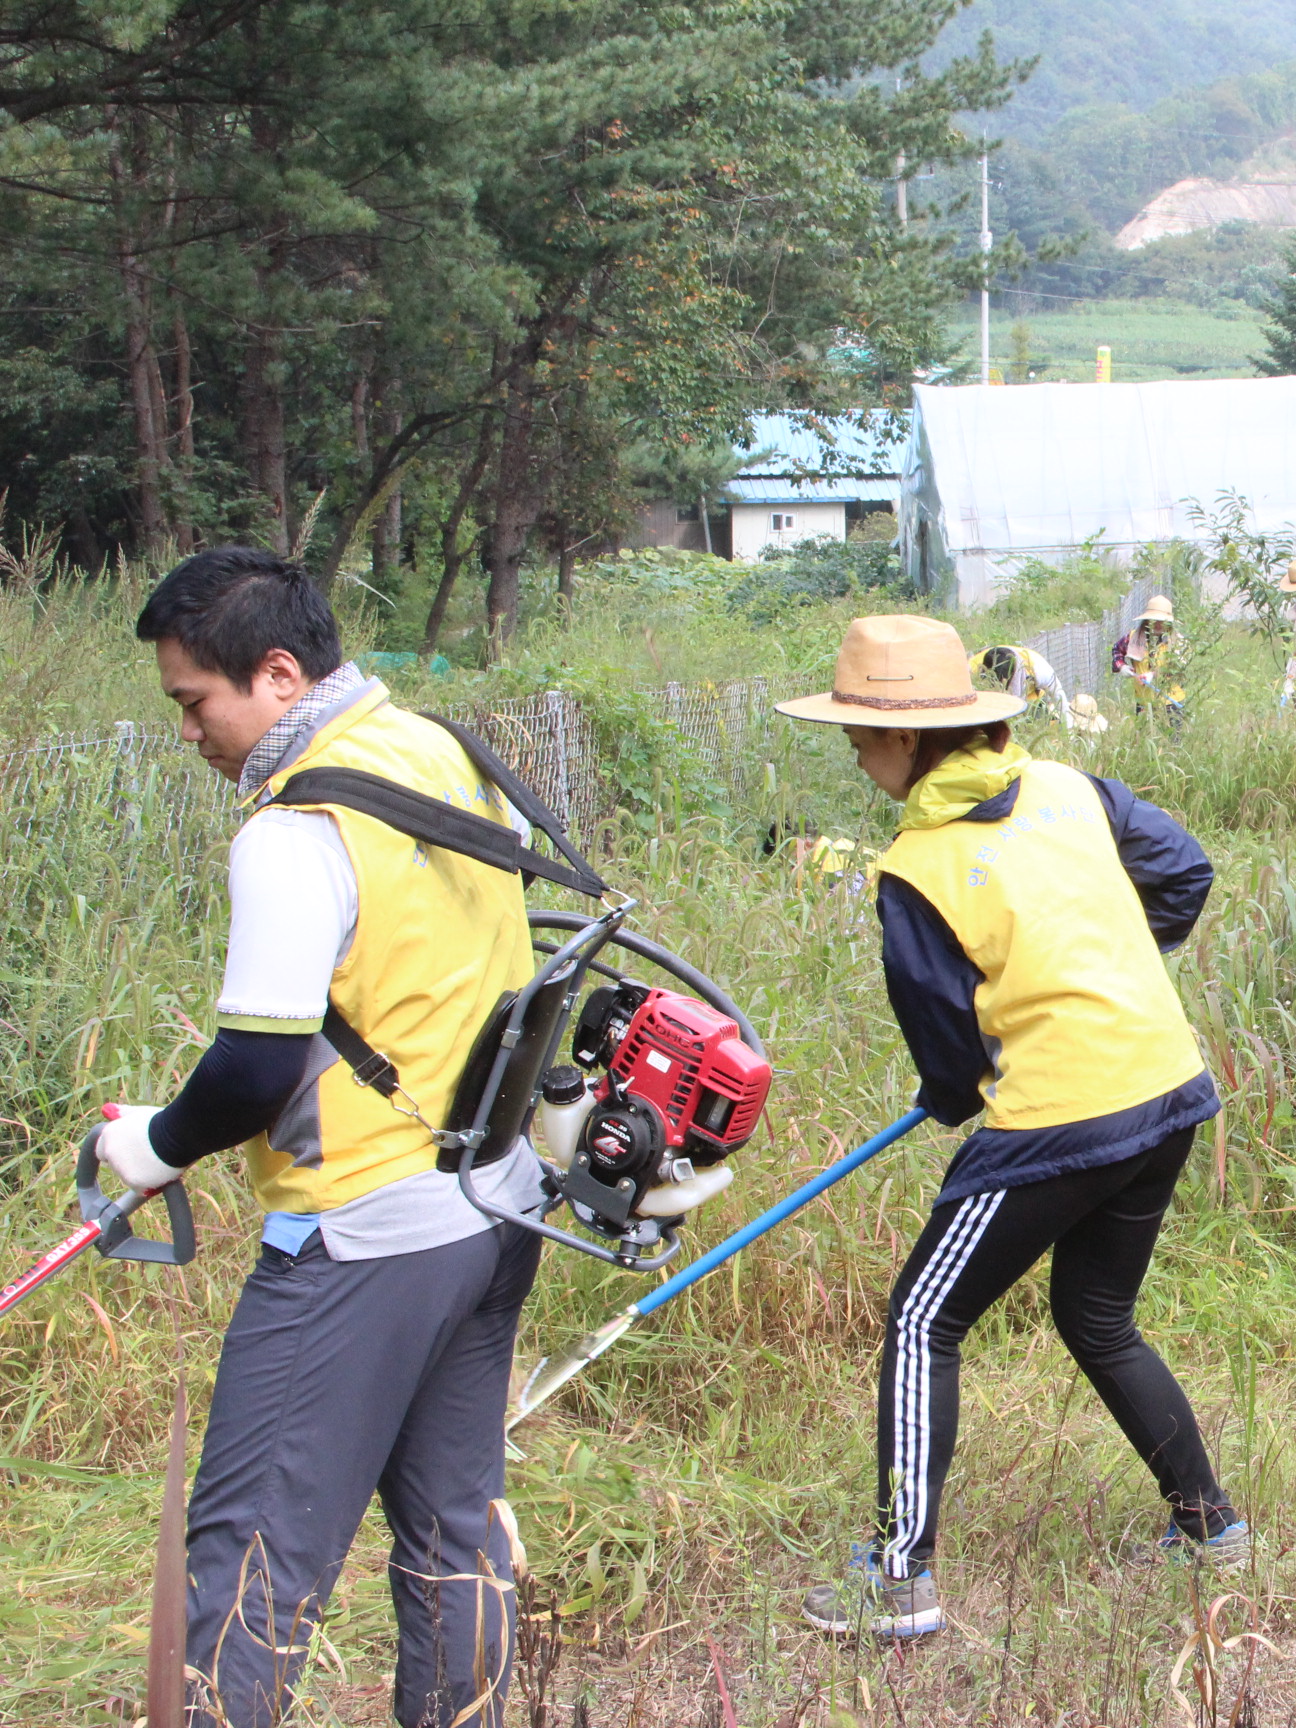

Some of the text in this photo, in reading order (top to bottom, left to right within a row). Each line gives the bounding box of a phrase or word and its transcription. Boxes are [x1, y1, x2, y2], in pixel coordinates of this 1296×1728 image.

[967, 805, 1096, 887] 안전 사랑 봉사단
[655, 1024, 690, 1048] OHC
[600, 1121, 631, 1143] HONDA
